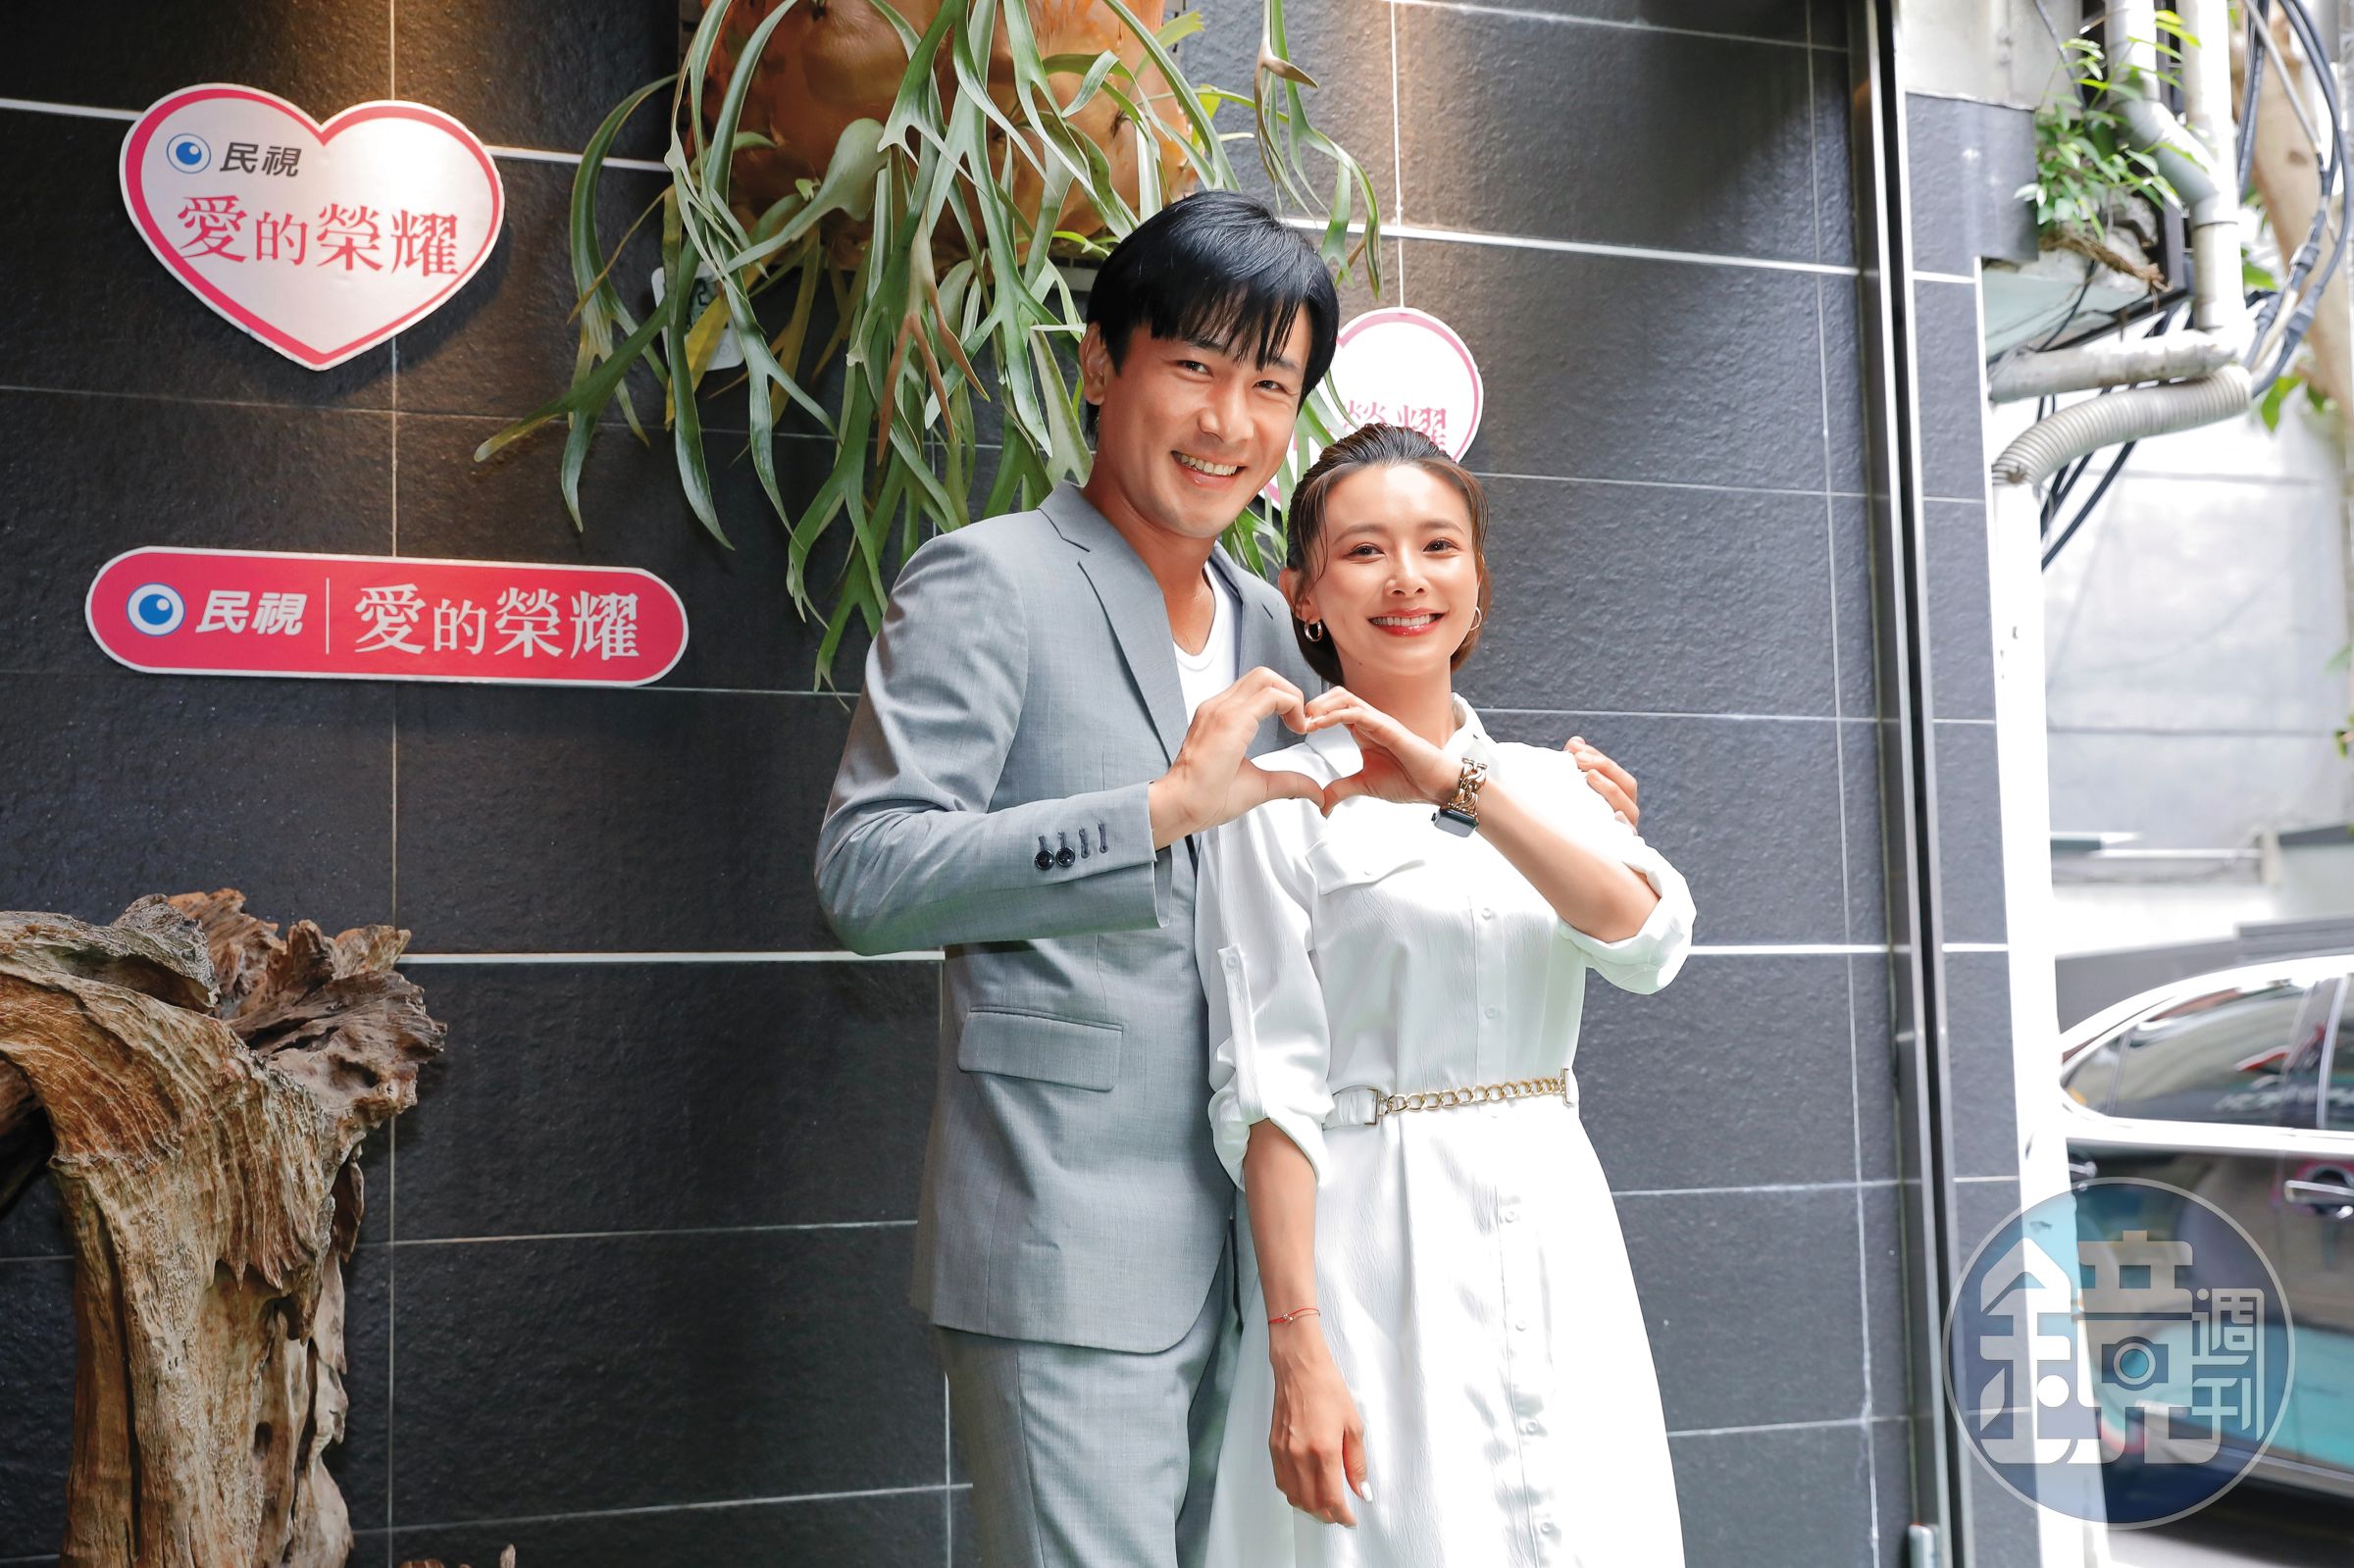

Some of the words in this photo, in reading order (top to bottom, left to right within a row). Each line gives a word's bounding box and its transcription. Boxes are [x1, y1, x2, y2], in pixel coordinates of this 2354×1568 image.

[219, 141, 302, 177] 民視
[178, 195, 459, 278] 愛的榮耀
[196, 588, 307, 635] 民視
[354, 583, 641, 661] 愛的榮耀
